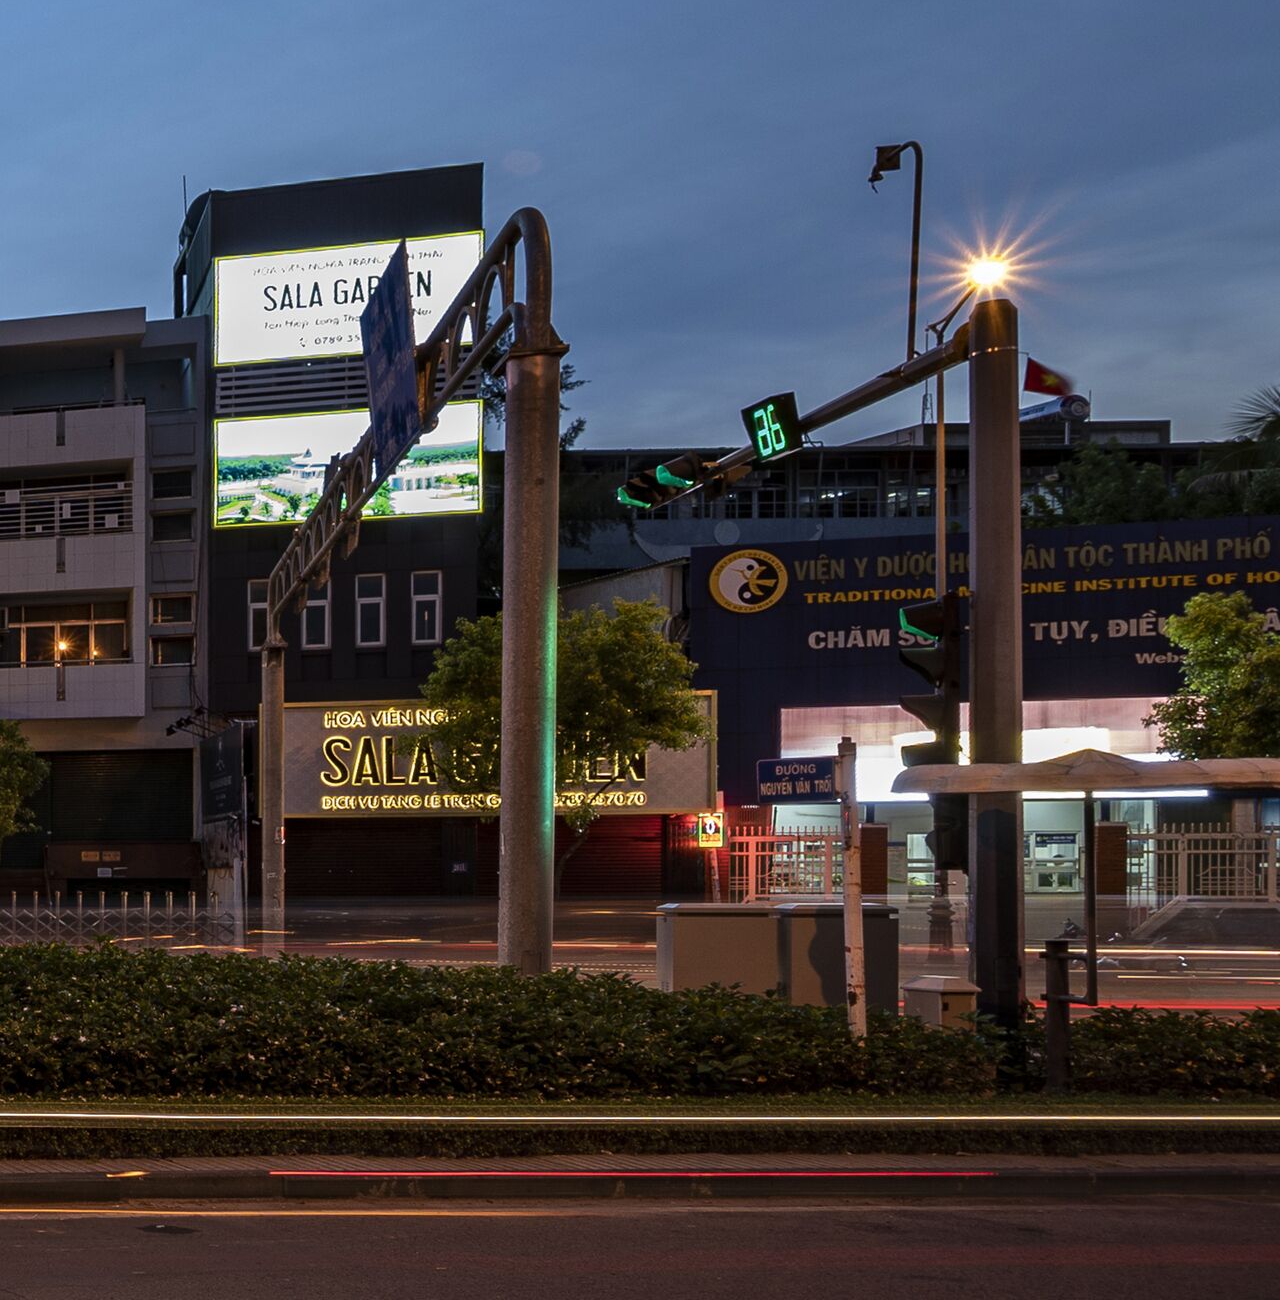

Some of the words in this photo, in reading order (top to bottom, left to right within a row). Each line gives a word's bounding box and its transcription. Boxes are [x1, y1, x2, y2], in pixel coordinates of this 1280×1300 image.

[263, 281, 323, 312] SALA
[333, 270, 432, 304] GARN
[793, 554, 846, 584] VIỆN
[854, 556, 869, 579] Y
[877, 551, 936, 581] DƯỢC
[1022, 543, 1056, 571] ÂN
[1064, 540, 1114, 573] TỘC
[1123, 535, 1209, 565] THÀNH
[1217, 527, 1272, 560] PHỐ
[804, 588, 937, 604] TRADITIONA
[1075, 574, 1198, 592] INSTITUTE
[1206, 572, 1238, 585] OF
[808, 625, 890, 649] CHĂM
[1030, 620, 1098, 645] TỤY,
[1135, 652, 1186, 665] Webs
[324, 711, 366, 728] HOA
[371, 707, 413, 727] VIÊN
[320, 735, 438, 787] SALA
[775, 762, 816, 775] ĐƯỜNG
[760, 777, 793, 796] NGUYỄN
[795, 777, 811, 794] VĂN
[814, 774, 832, 793] TRỖI
[321, 795, 357, 811] DỊCH
[359, 795, 380, 812] VỤ
[381, 794, 422, 809] TANG
